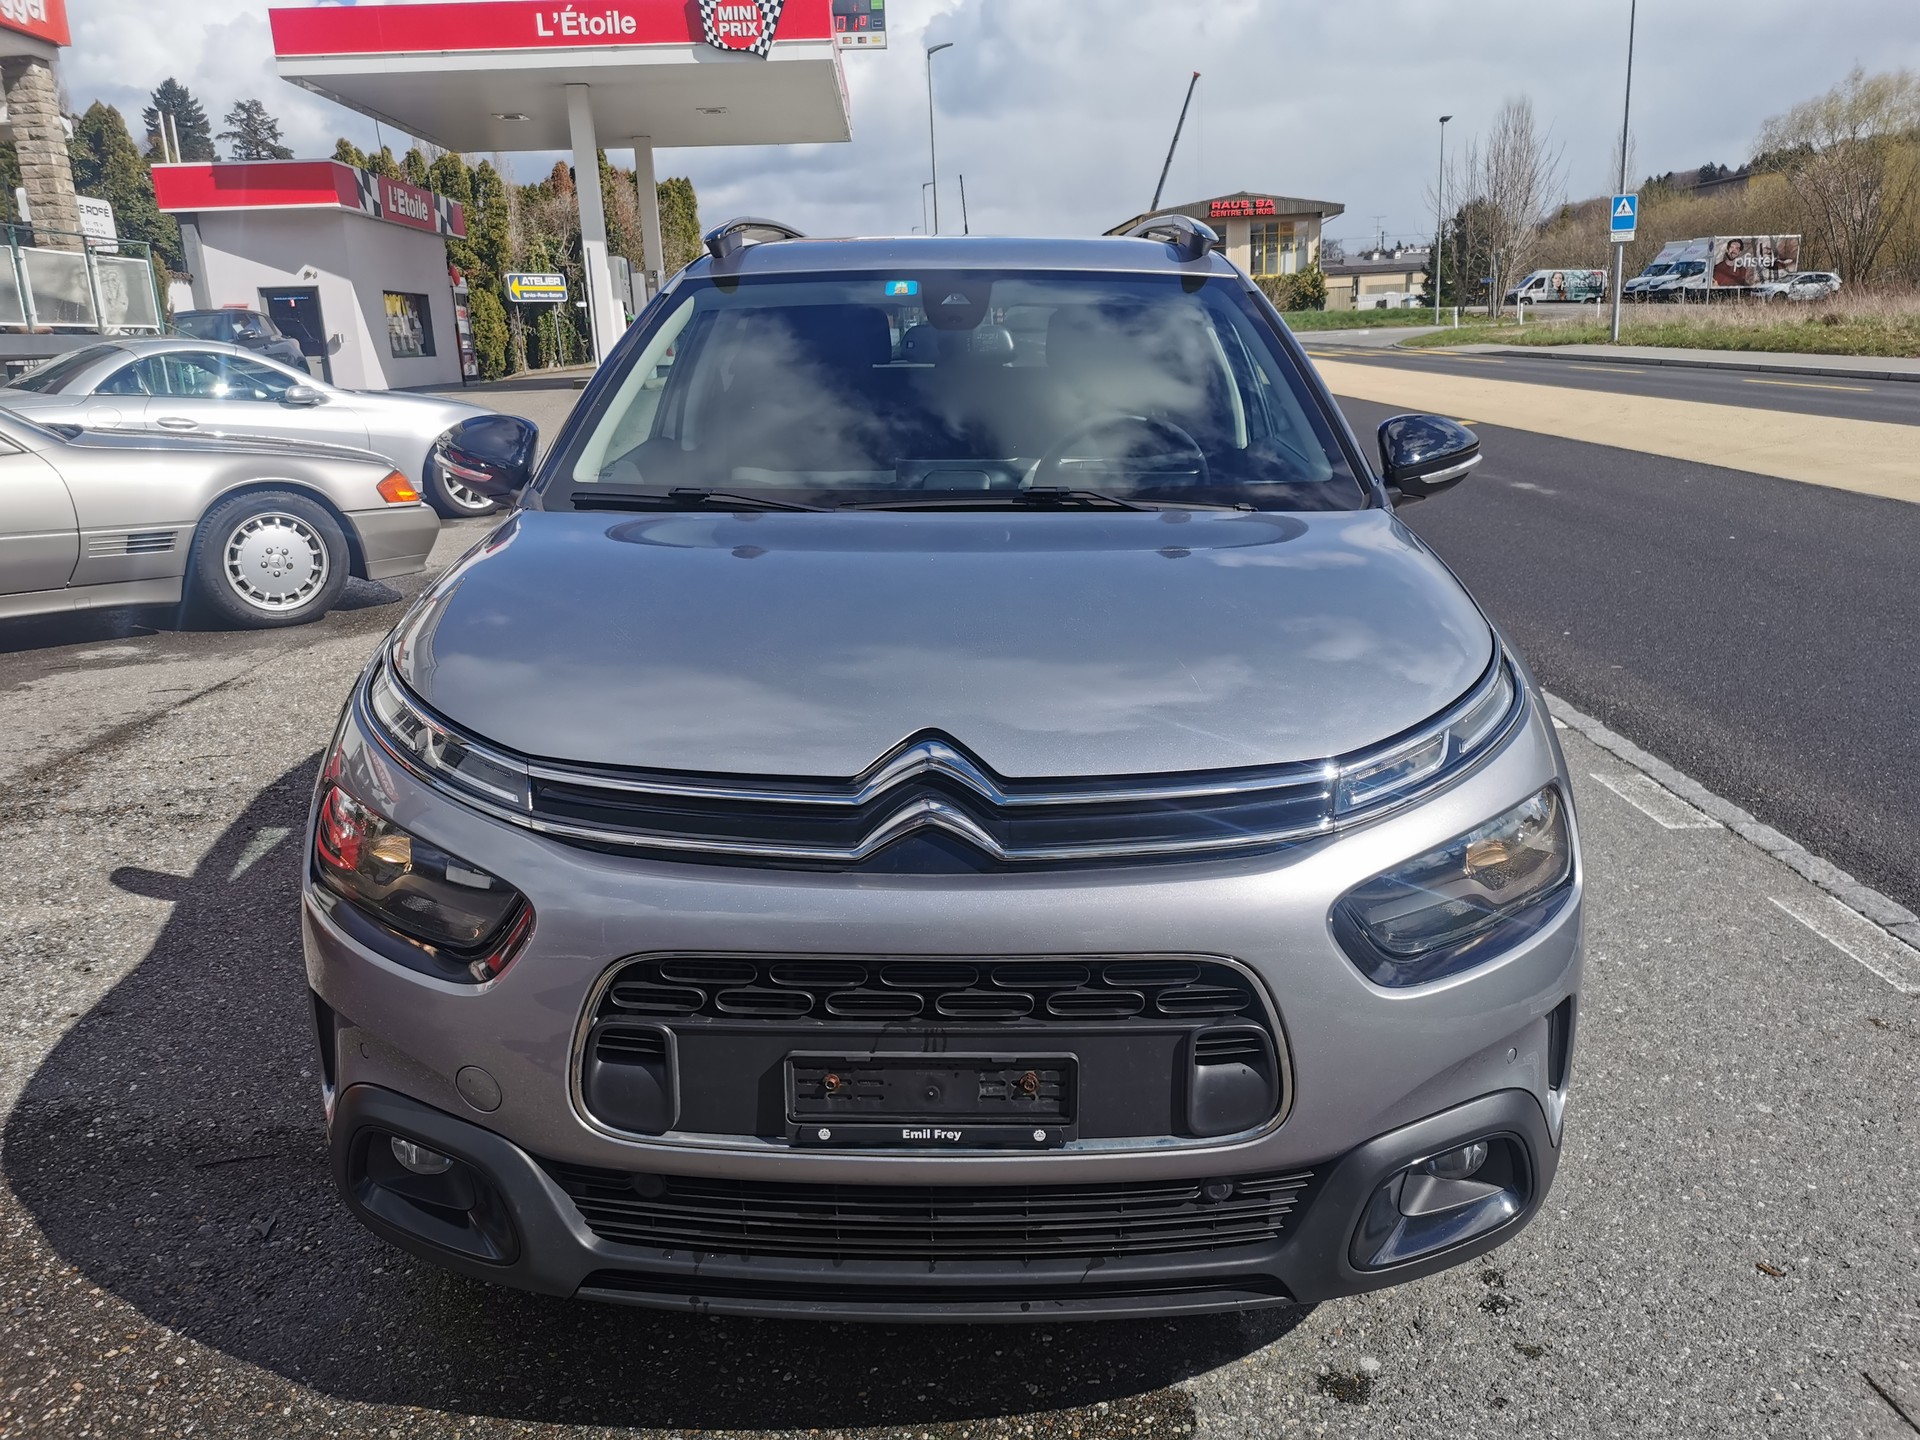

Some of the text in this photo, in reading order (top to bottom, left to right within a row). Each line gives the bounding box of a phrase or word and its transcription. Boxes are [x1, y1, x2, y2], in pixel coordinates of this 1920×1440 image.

[536, 4, 637, 37] L'Étoile
[717, 5, 757, 21] MINI
[719, 22, 759, 37] PRIX
[1210, 210, 1241, 218] CENTRE
[1733, 252, 1778, 272] pfister
[521, 276, 561, 286] ATELIER
[902, 1129, 962, 1141] Emil Frey
